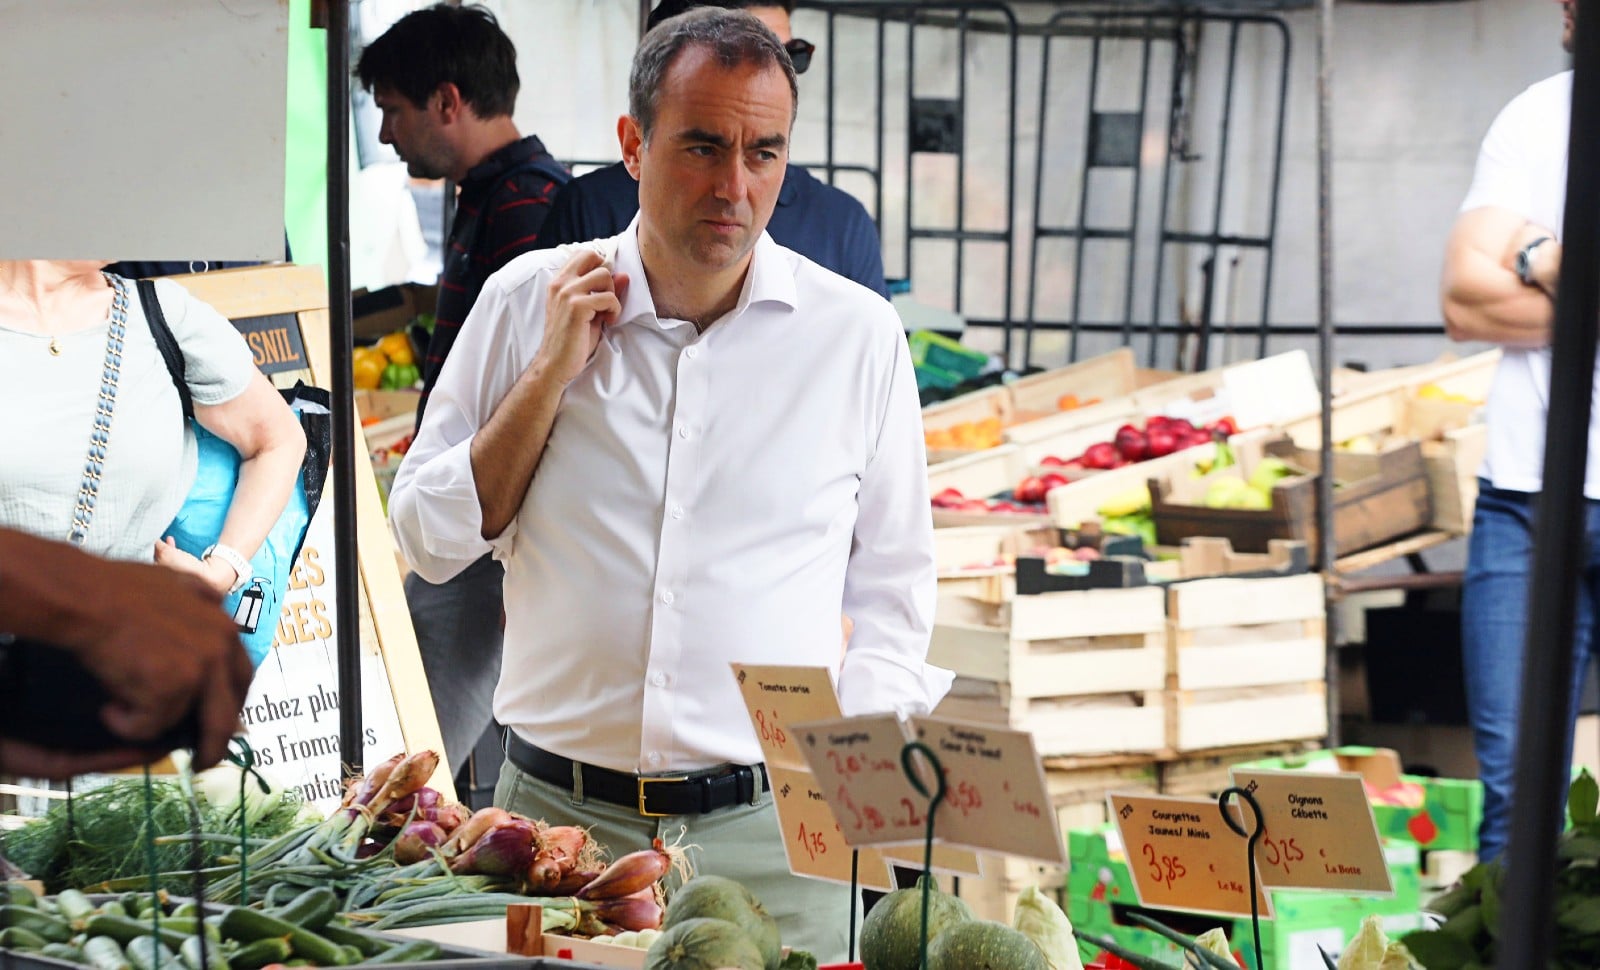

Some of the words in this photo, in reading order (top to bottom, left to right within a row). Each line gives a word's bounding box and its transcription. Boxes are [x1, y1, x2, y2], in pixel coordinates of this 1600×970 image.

[241, 327, 300, 366] SNIL
[287, 546, 325, 592] ES
[272, 599, 332, 649] GES
[239, 693, 303, 725] erchez
[308, 684, 340, 723] plu
[758, 681, 787, 693] Tomates
[276, 728, 377, 763] Fromas
[1245, 780, 1259, 794] 32
[1288, 793, 1324, 806] Oignons
[1152, 809, 1201, 823] Courgettes
[1187, 828, 1211, 840] Minis
[1142, 843, 1187, 891] 3,85
